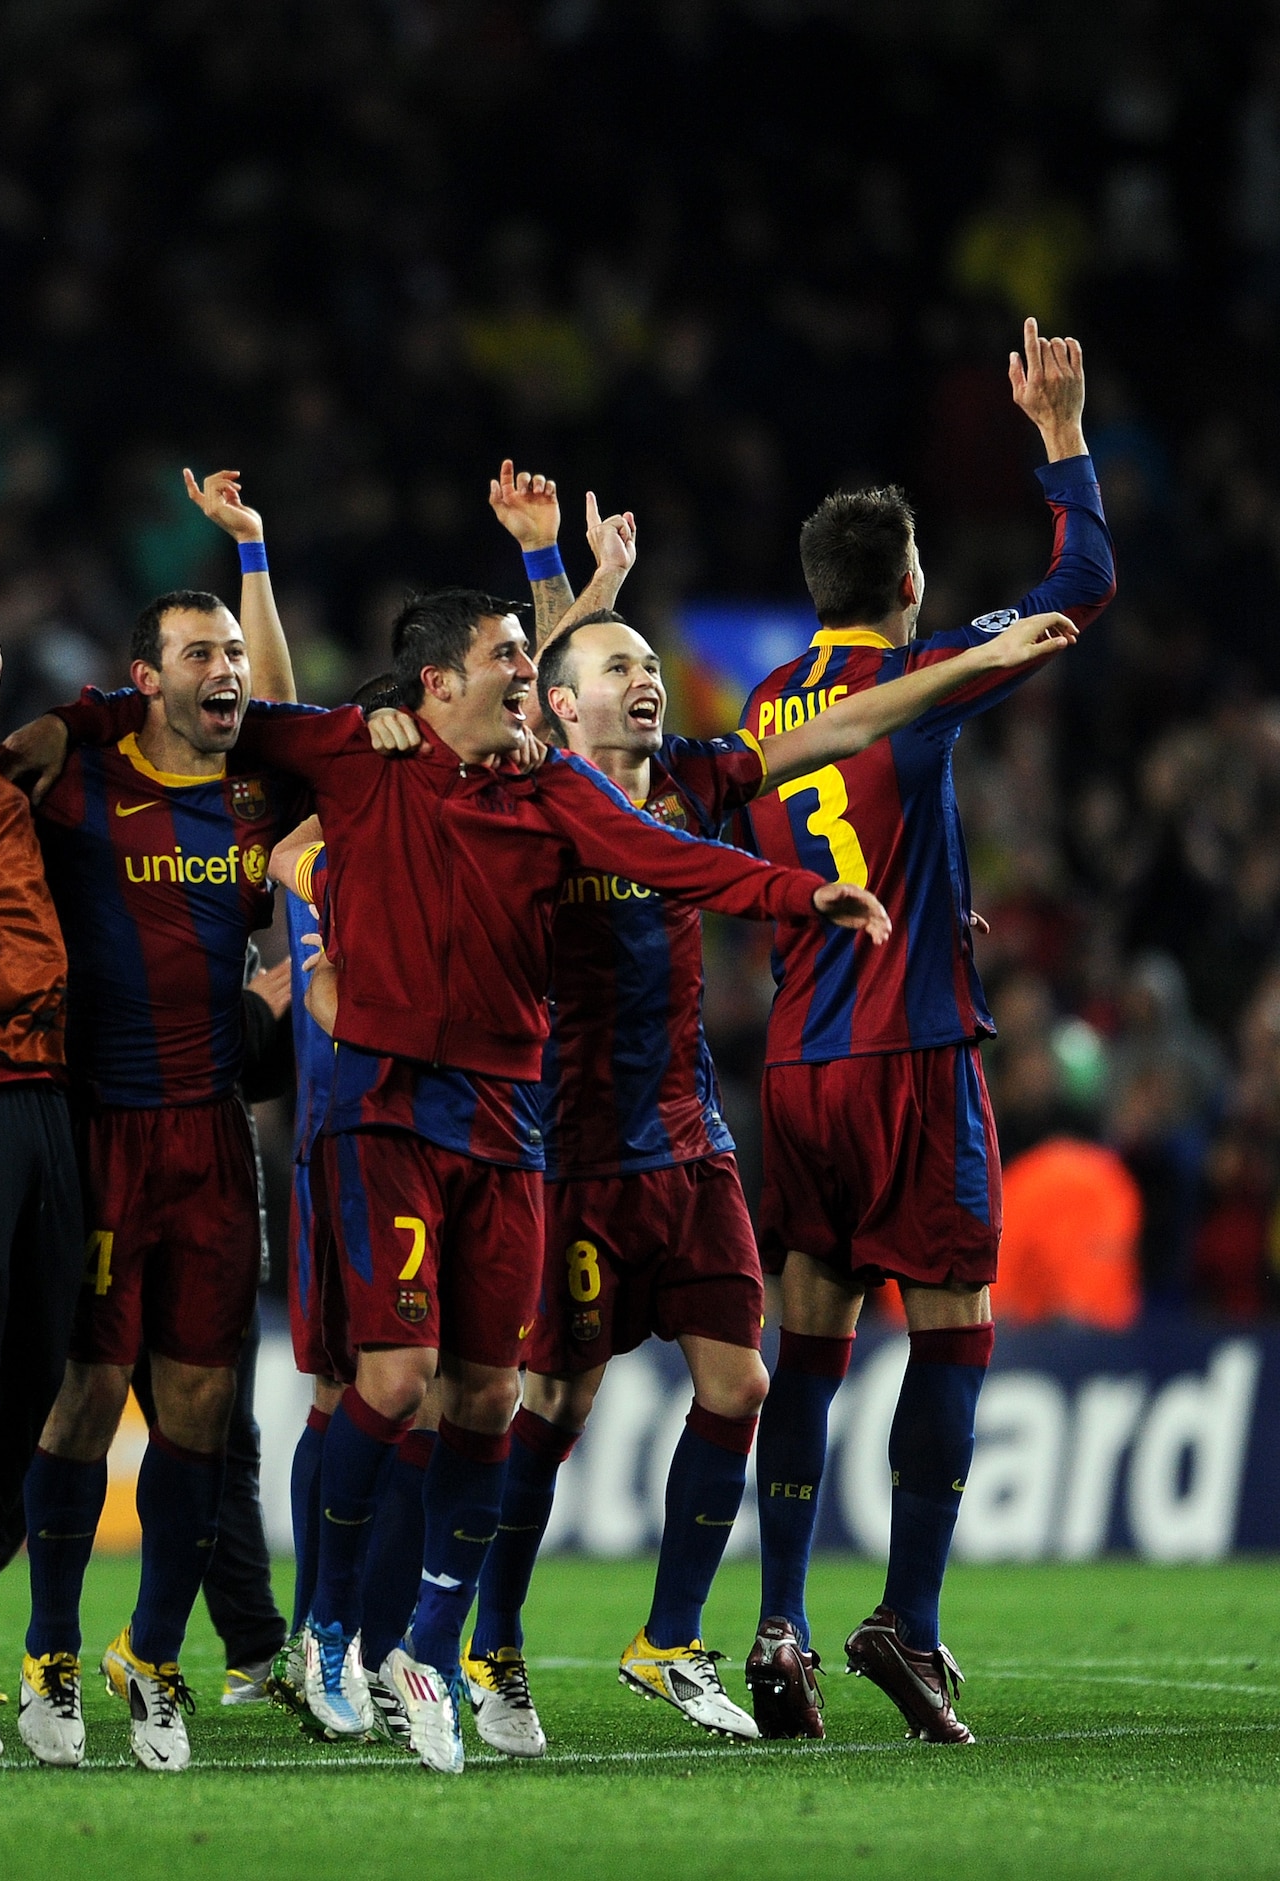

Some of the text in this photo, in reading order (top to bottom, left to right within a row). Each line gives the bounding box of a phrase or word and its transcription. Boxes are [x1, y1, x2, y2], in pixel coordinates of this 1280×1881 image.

[777, 763, 868, 889] 3
[125, 845, 239, 884] unicef
[394, 1216, 426, 1281] 7
[567, 1240, 601, 1302] 8
[770, 1481, 813, 1500] FCB
